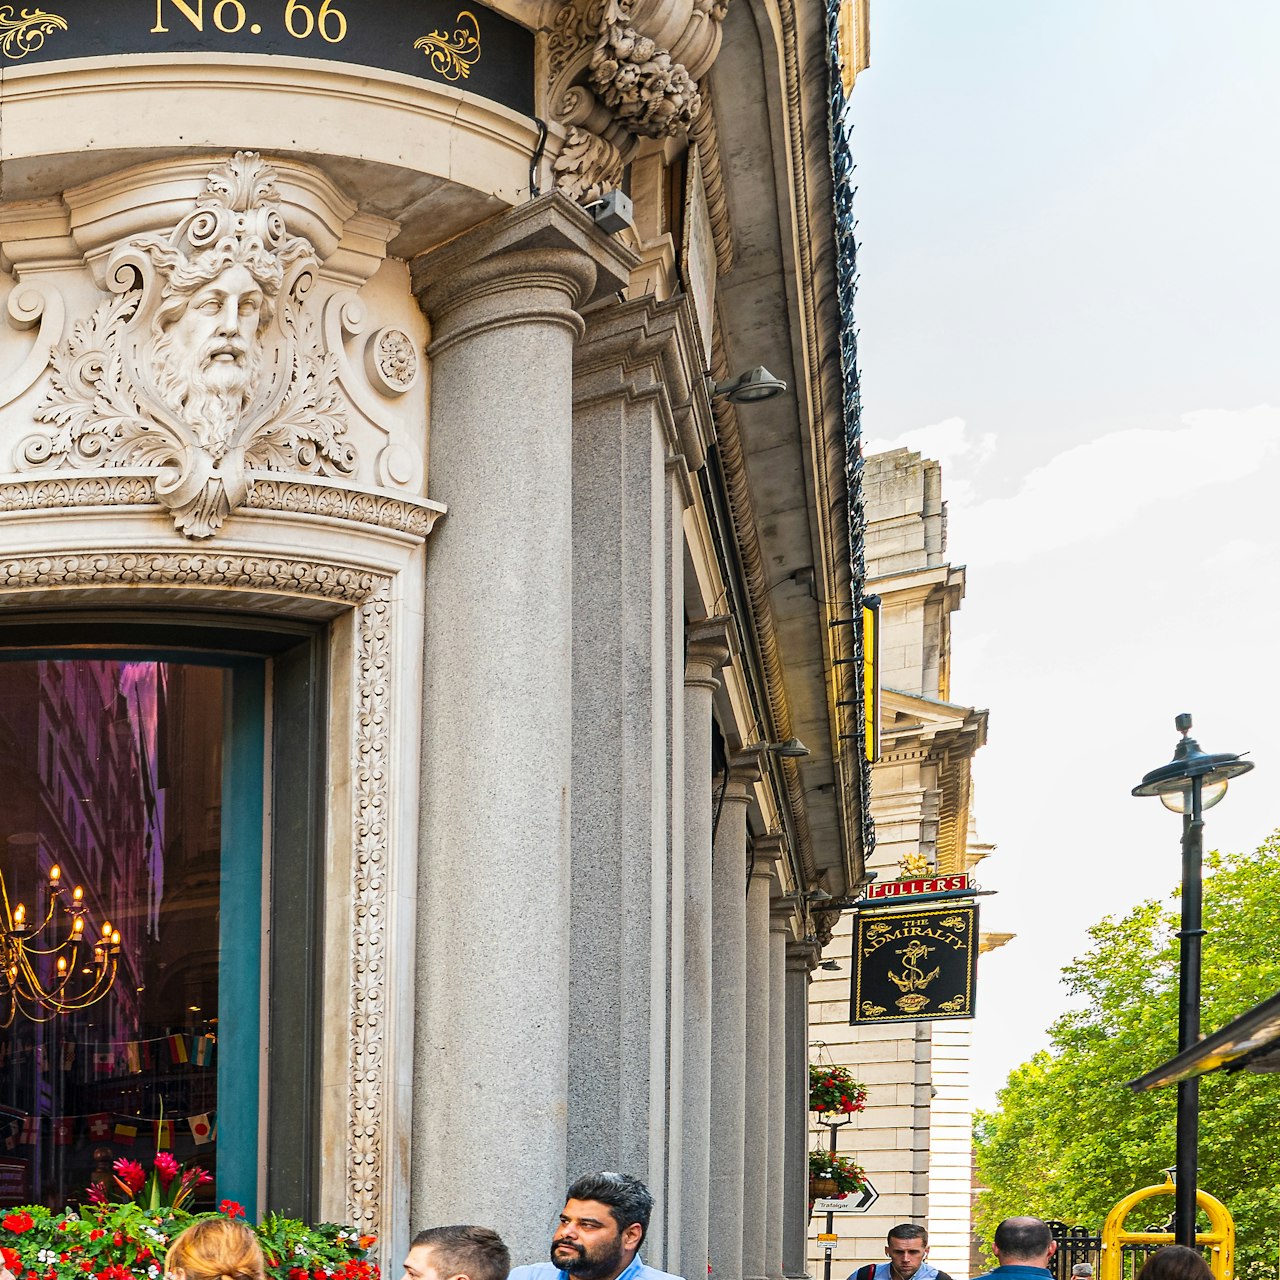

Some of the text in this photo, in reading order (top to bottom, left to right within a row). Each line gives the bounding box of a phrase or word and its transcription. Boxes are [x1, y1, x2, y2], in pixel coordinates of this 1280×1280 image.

[150, 0, 348, 43] No. 66
[872, 878, 962, 898] FULLER'S
[901, 918, 930, 927] THE
[863, 926, 968, 958] ADMIRALTY
